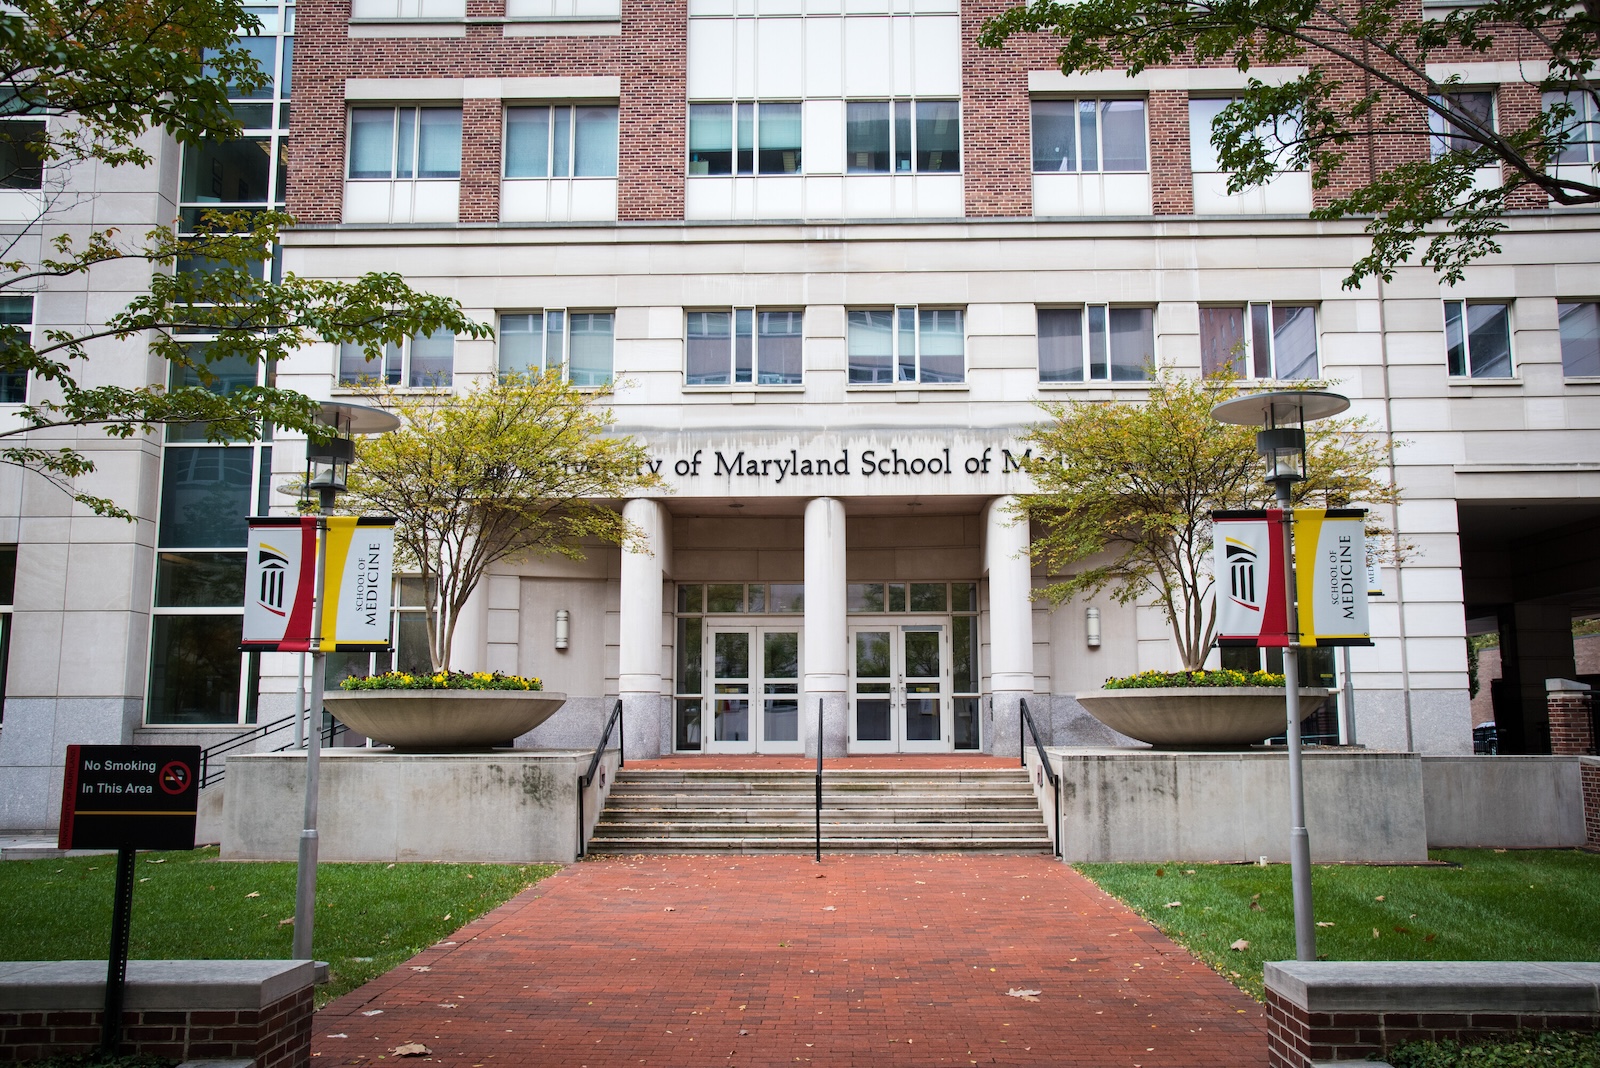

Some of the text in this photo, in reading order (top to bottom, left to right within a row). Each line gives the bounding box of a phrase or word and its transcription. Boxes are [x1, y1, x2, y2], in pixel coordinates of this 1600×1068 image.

[674, 449, 702, 476] of
[714, 449, 850, 484] Maryland
[861, 448, 952, 476] School
[964, 447, 992, 475] of
[356, 557, 366, 612] SCHOOL OF
[365, 543, 381, 626] MEDICINE
[1329, 550, 1339, 605] SCHOOL OF
[1339, 535, 1355, 620] MEDICINE
[82, 783, 153, 794] In This Area
[84, 760, 157, 774] No Smoking
